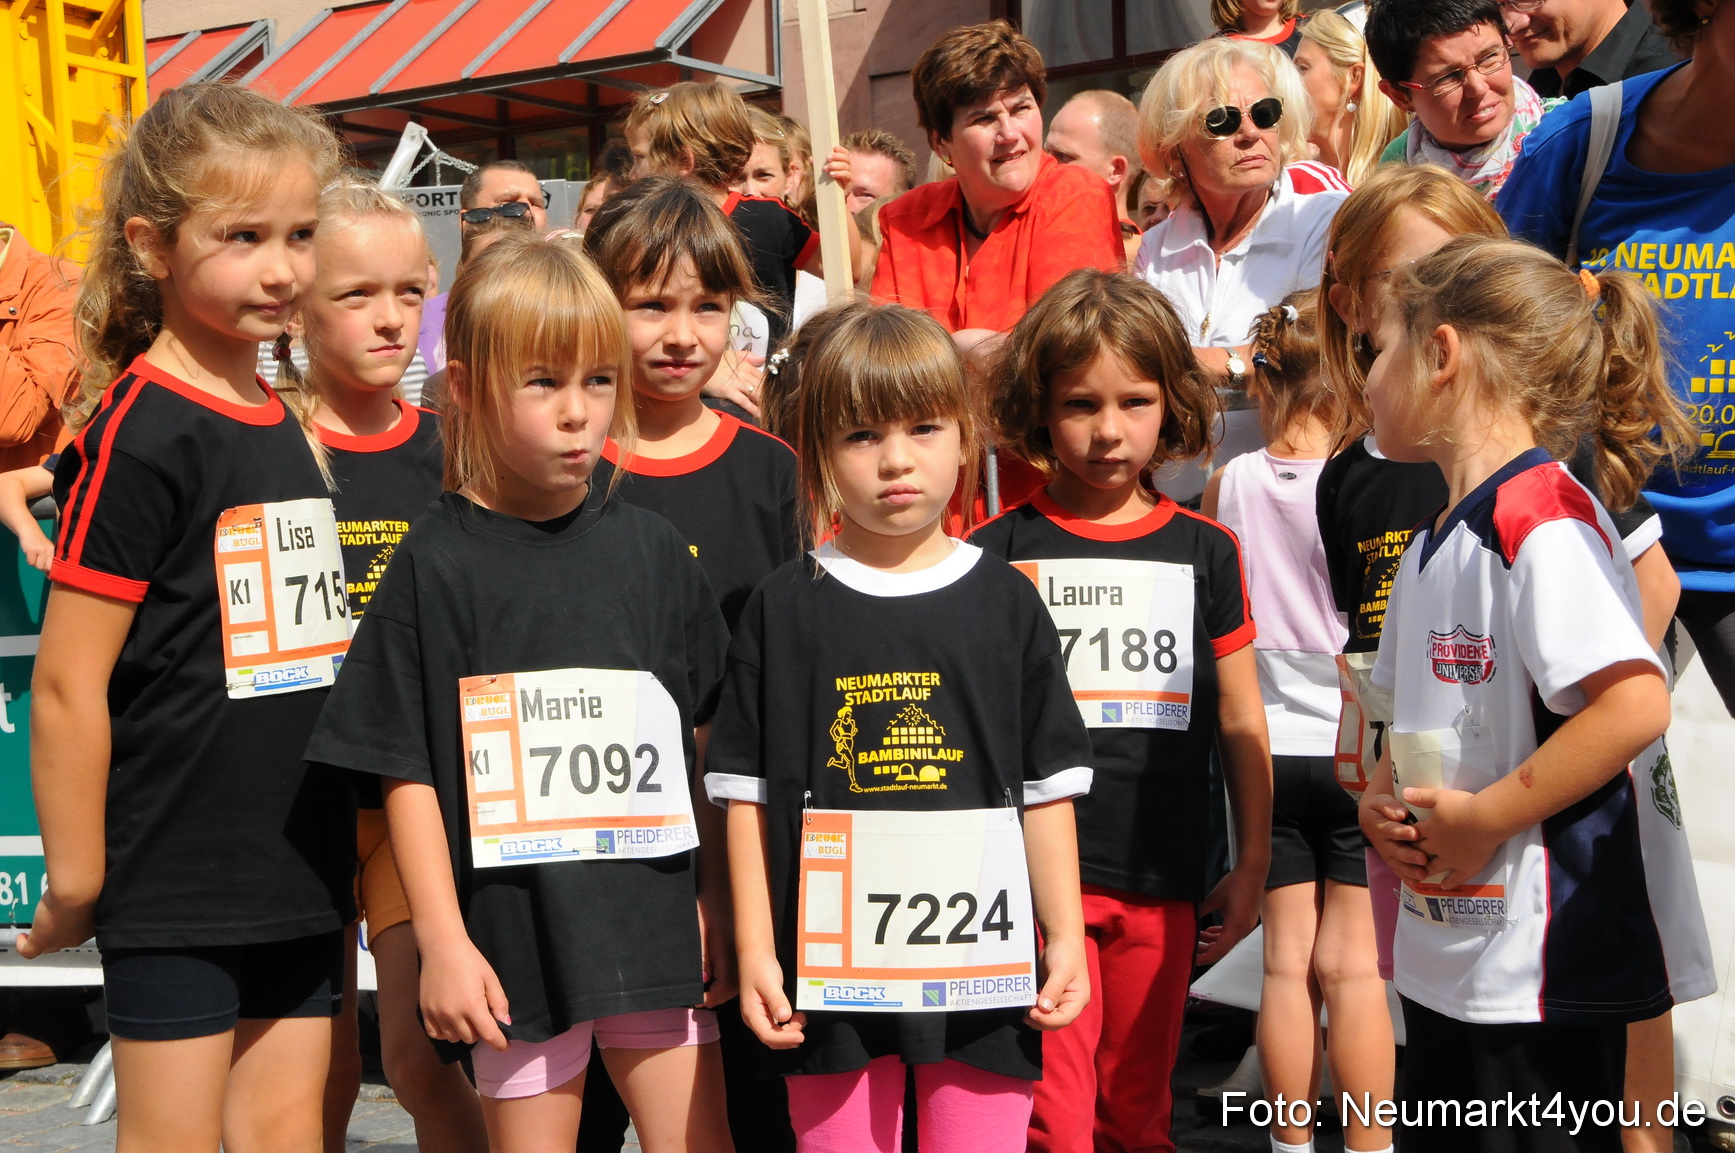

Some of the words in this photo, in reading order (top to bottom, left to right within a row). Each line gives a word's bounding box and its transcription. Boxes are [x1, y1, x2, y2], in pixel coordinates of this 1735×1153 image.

[276, 517, 315, 552] Lisa
[336, 520, 409, 532] EUMARKTER
[338, 532, 402, 546] TADTLAUF
[230, 578, 251, 606] K1
[285, 570, 351, 626] 715
[1049, 576, 1123, 606] Laura
[1360, 599, 1387, 614] BAMB
[1058, 627, 1178, 674] 7188
[254, 666, 309, 685] BOCK
[836, 672, 941, 692] NEUMARKTER
[520, 687, 603, 723] Marie
[845, 687, 931, 706] STADTLAUF
[481, 707, 510, 717] BÜGL
[1125, 702, 1188, 718] PFLEIDERER
[468, 749, 490, 776] K1
[858, 747, 964, 764] BAMBINILAUF
[529, 743, 663, 797] 7092
[864, 783, 948, 793] www.stadtlauf-neumarkt.de
[617, 826, 694, 845] PFLEIDERER
[500, 837, 563, 855] BOCK
[818, 845, 845, 855] BÜGL
[1441, 898, 1505, 915] PFLEIDERER
[867, 889, 1014, 945] 7224
[823, 985, 886, 1001] BOCK
[950, 976, 1032, 996] PFLEIDERER
[950, 993, 1032, 1007] AKTIENGESELLSCHAFT
